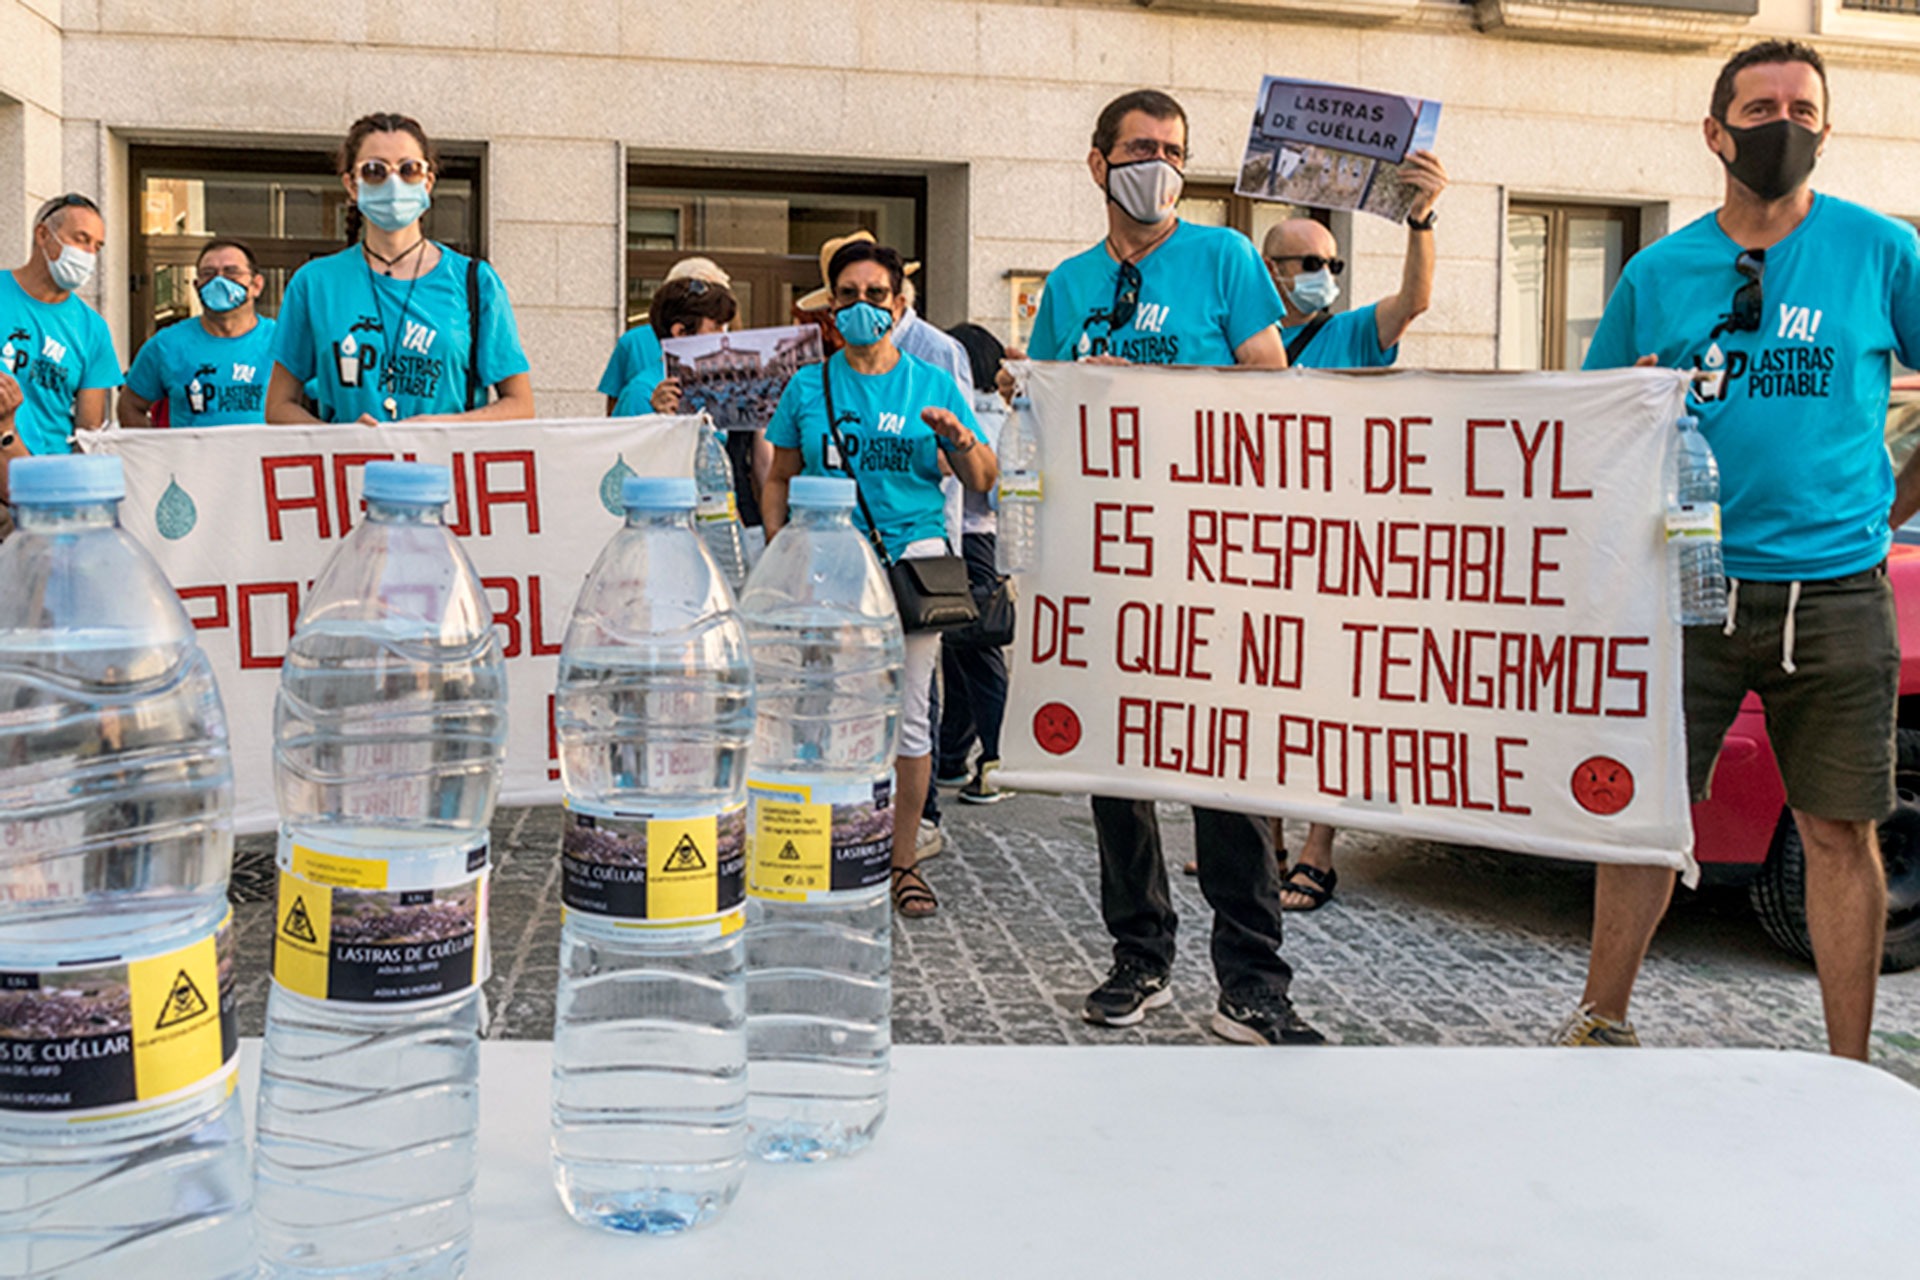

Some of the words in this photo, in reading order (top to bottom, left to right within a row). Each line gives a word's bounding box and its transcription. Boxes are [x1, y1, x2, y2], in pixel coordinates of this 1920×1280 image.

[1293, 95, 1384, 123] LASTRAS
[1271, 113, 1297, 131] DE
[1306, 120, 1398, 151] CUÉLLAR
[1134, 301, 1170, 333] YA!
[1777, 303, 1823, 342] YA!
[402, 319, 437, 355] YA!
[380, 352, 443, 380] LASTRAS
[1749, 346, 1835, 373] LASTRAS
[1748, 371, 1830, 399] POTABLE
[877, 411, 906, 435] YA!
[1079, 405, 1140, 478] LA
[1171, 410, 1332, 492] JUNTA
[1364, 417, 1432, 495] DE
[1466, 420, 1592, 499] CYL
[1093, 503, 1153, 577] ES
[1187, 509, 1566, 607] RESPONSABLE
[1032, 595, 1089, 668] DE
[1116, 601, 1214, 680] QUE
[1239, 612, 1304, 689] NO
[1342, 623, 1649, 717] TENGAMOS
[1117, 697, 1249, 780] AGUA
[1277, 714, 1531, 815] POTABLE
[592, 863, 645, 884] CUÉLLAR
[336, 946, 402, 963] LASTRAS
[404, 948, 423, 961] DE
[12, 1043, 36, 1062] DE
[41, 1034, 131, 1062] CUÉLLAR
